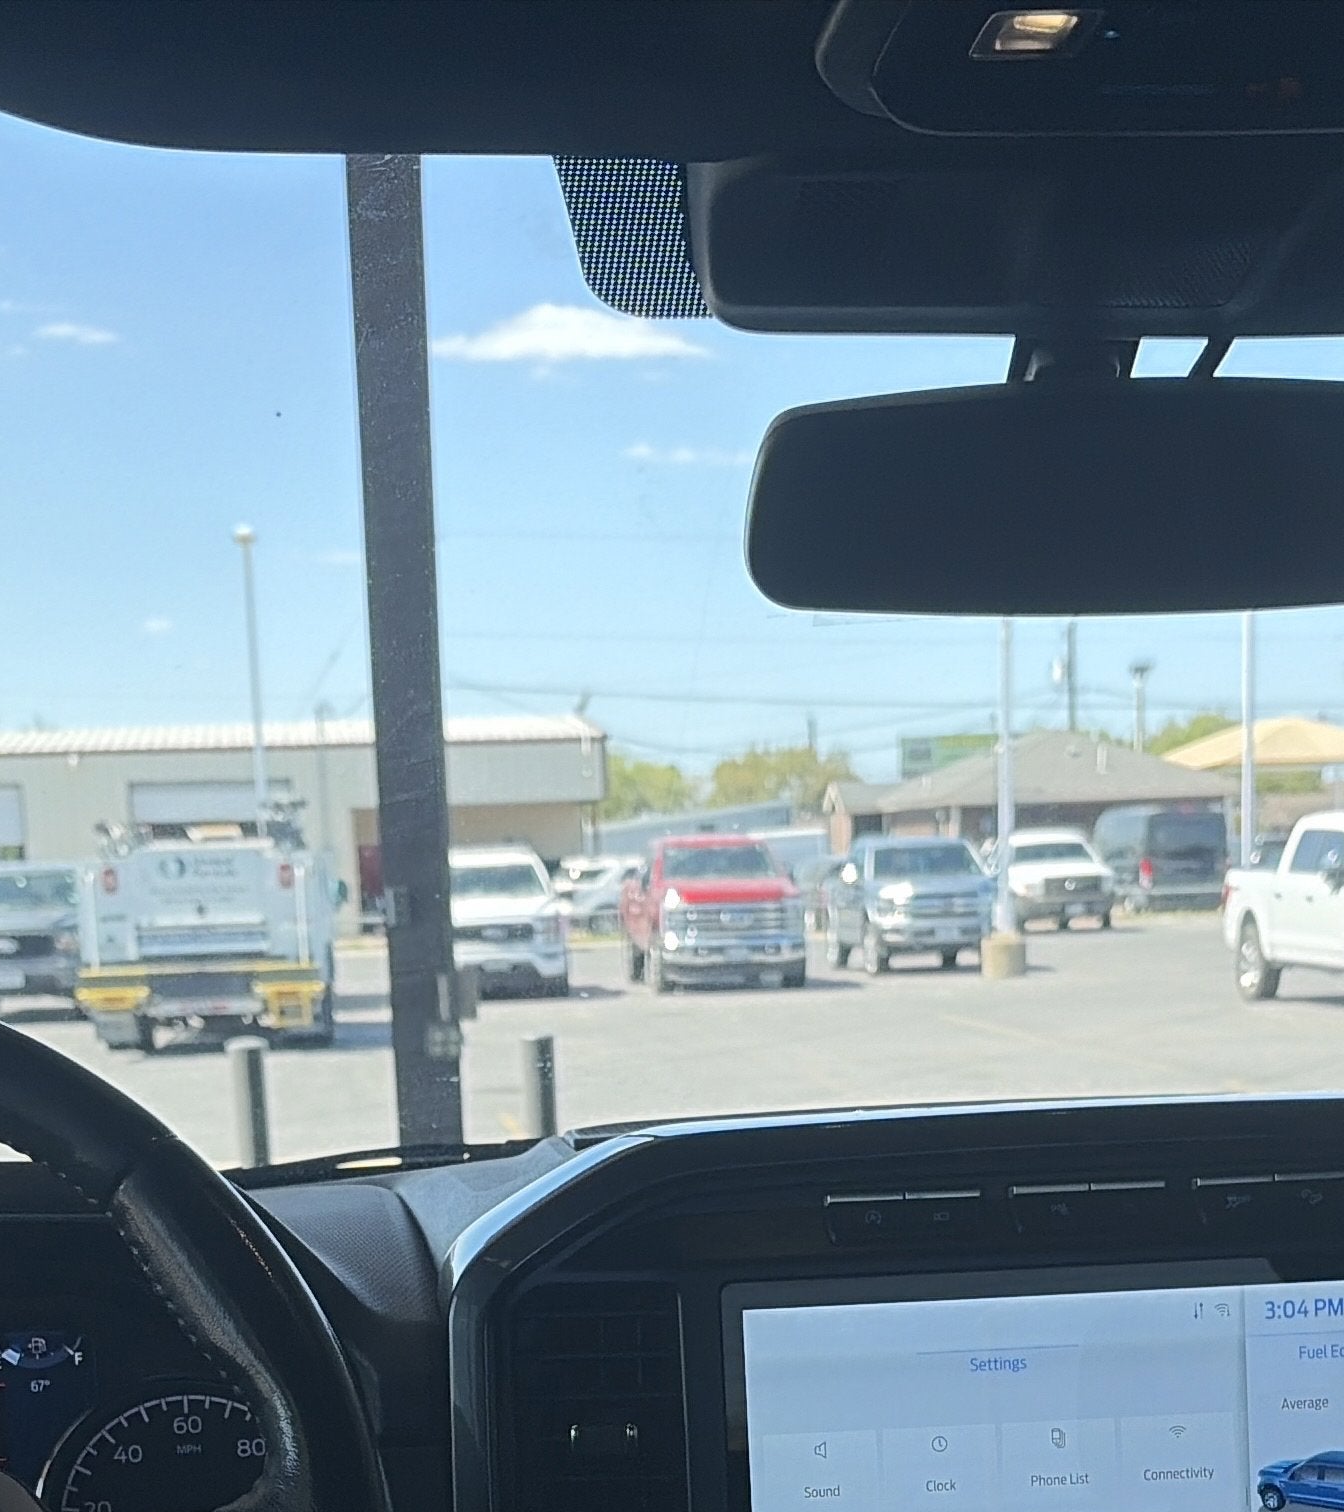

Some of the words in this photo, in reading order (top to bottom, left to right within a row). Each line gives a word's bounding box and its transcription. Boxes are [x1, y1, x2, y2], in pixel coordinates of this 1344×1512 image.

[1265, 1299, 1309, 1319] 3:04
[1314, 1298, 1344, 1317] PM
[74, 1351, 83, 1366] F
[1299, 1345, 1327, 1359] Fuel
[970, 1357, 1027, 1373] Settings
[1281, 1397, 1329, 1411] Average
[173, 1415, 203, 1434] 60
[113, 1444, 143, 1464] 40
[176, 1444, 202, 1455] MPH
[237, 1438, 266, 1458] 80
[1030, 1473, 1067, 1488] Phone
[1069, 1472, 1089, 1485] List
[1143, 1466, 1214, 1482] Connectivity
[805, 1485, 840, 1498] Sound
[926, 1479, 956, 1492] Clock
